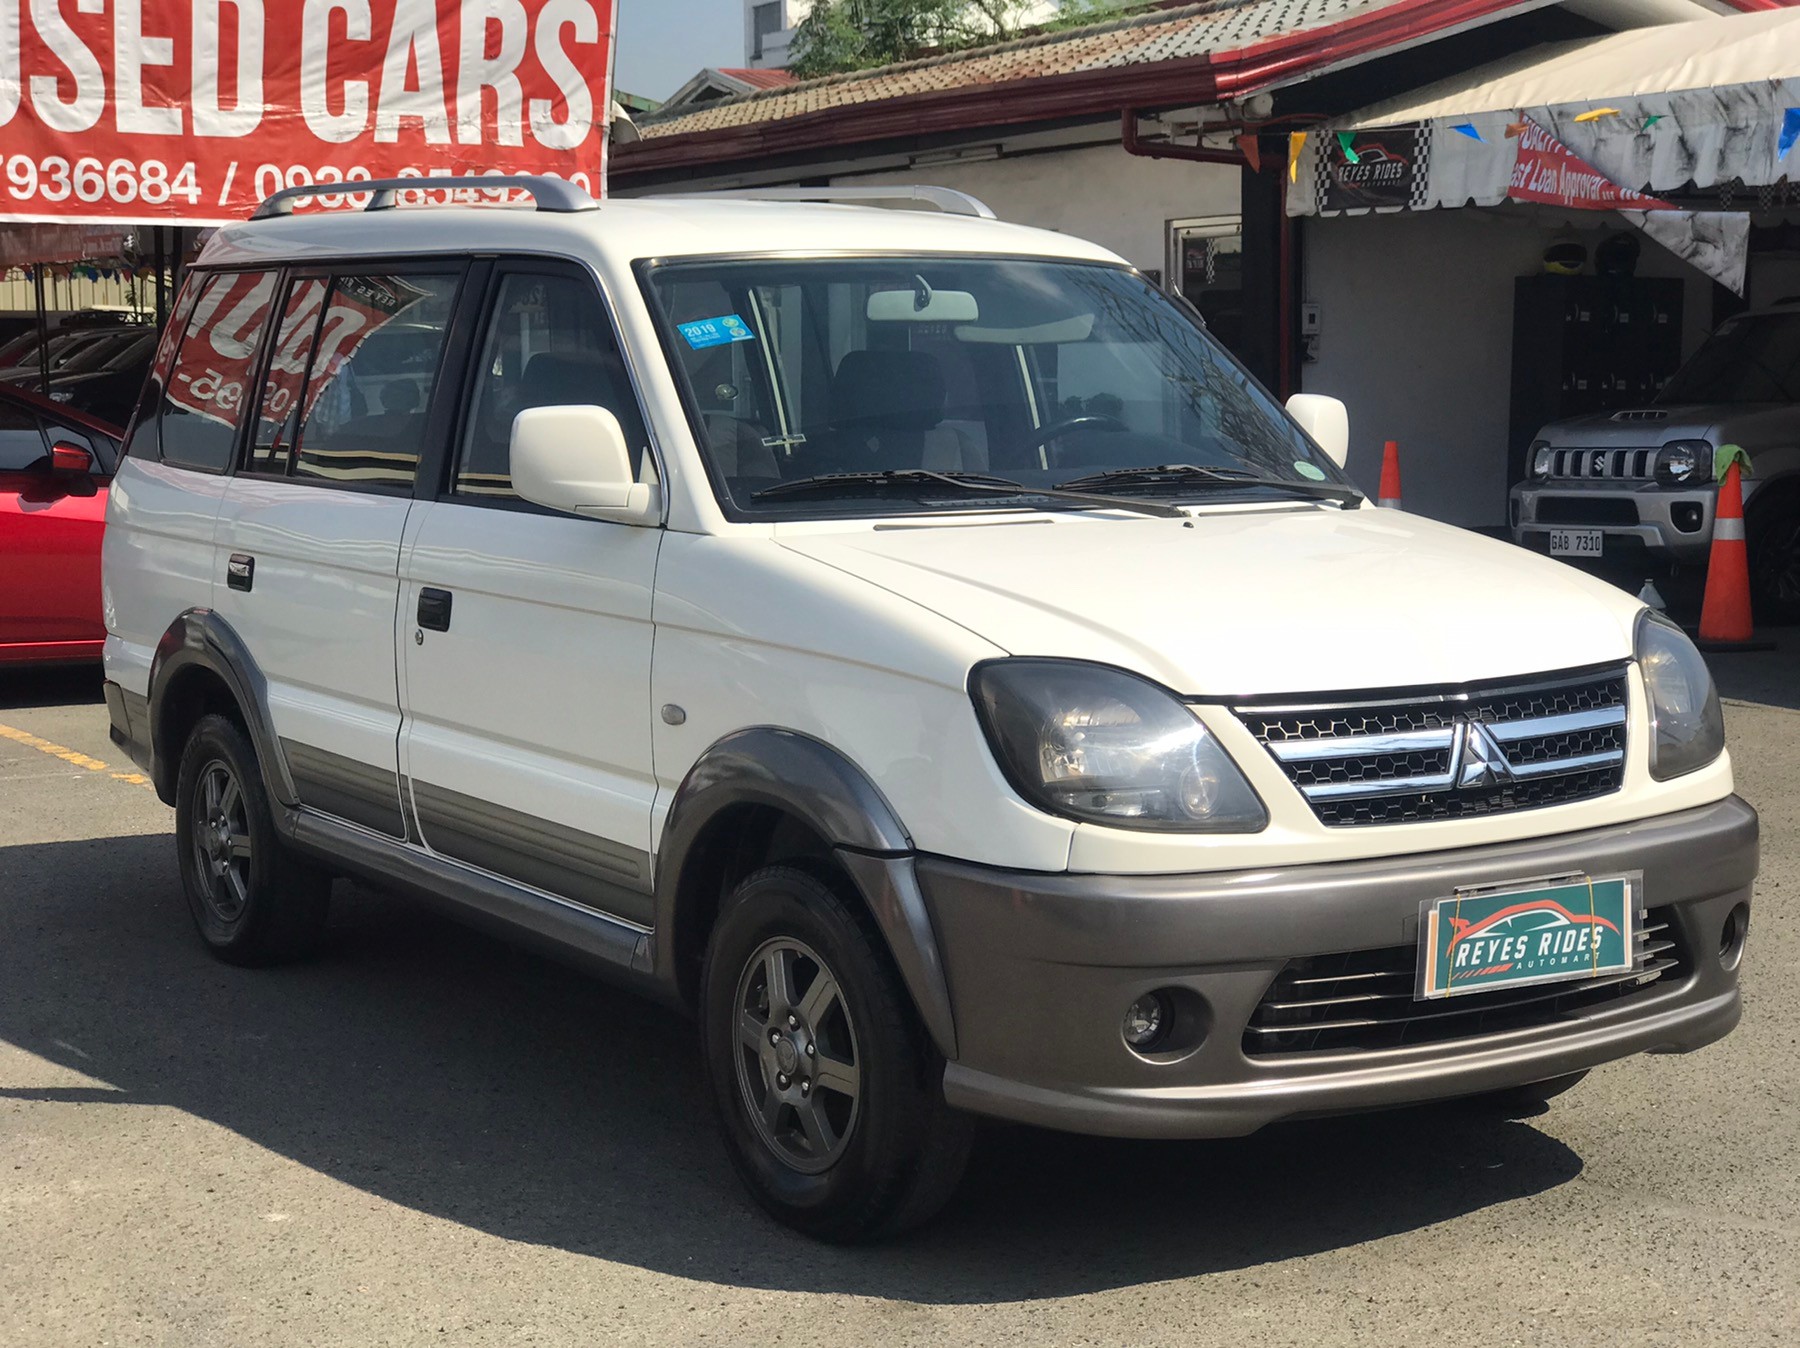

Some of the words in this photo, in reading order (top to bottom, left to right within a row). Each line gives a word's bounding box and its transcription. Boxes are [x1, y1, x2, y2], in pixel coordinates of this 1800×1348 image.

[300, 0, 599, 150] CARS
[0, 154, 202, 205] 936684
[1338, 165, 1371, 181] REYES
[1373, 162, 1403, 179] RIDES
[1510, 159, 1534, 188] ast
[1528, 159, 1557, 193] Loan
[685, 324, 716, 337] 2019
[1551, 535, 1570, 550] GAB
[1576, 535, 1601, 551] 7310
[1455, 935, 1529, 968] REYES
[1537, 926, 1604, 957] RIDES
[1516, 952, 1601, 970] AUTOMART
